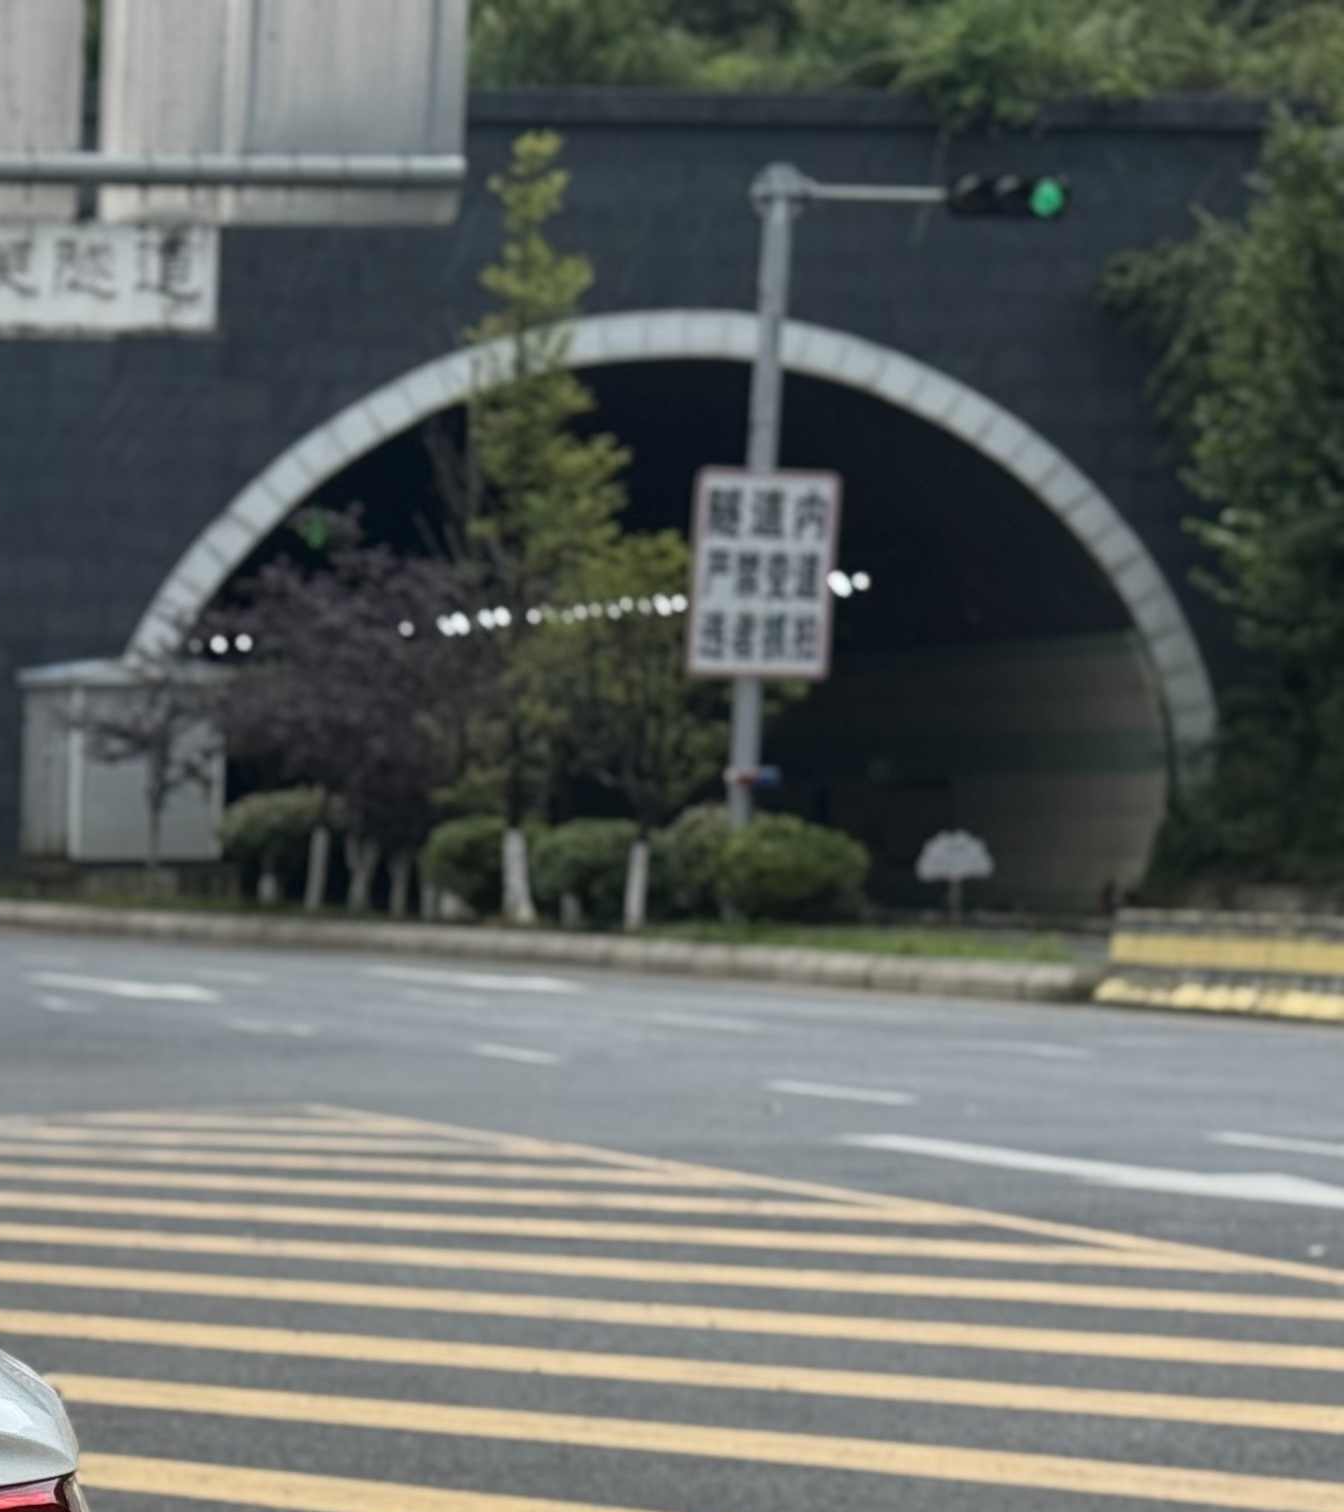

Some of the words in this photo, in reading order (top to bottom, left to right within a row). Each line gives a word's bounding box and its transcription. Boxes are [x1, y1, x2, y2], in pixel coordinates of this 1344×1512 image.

[708, 488, 826, 540] 隧道内
[703, 549, 819, 599] 严禁变道
